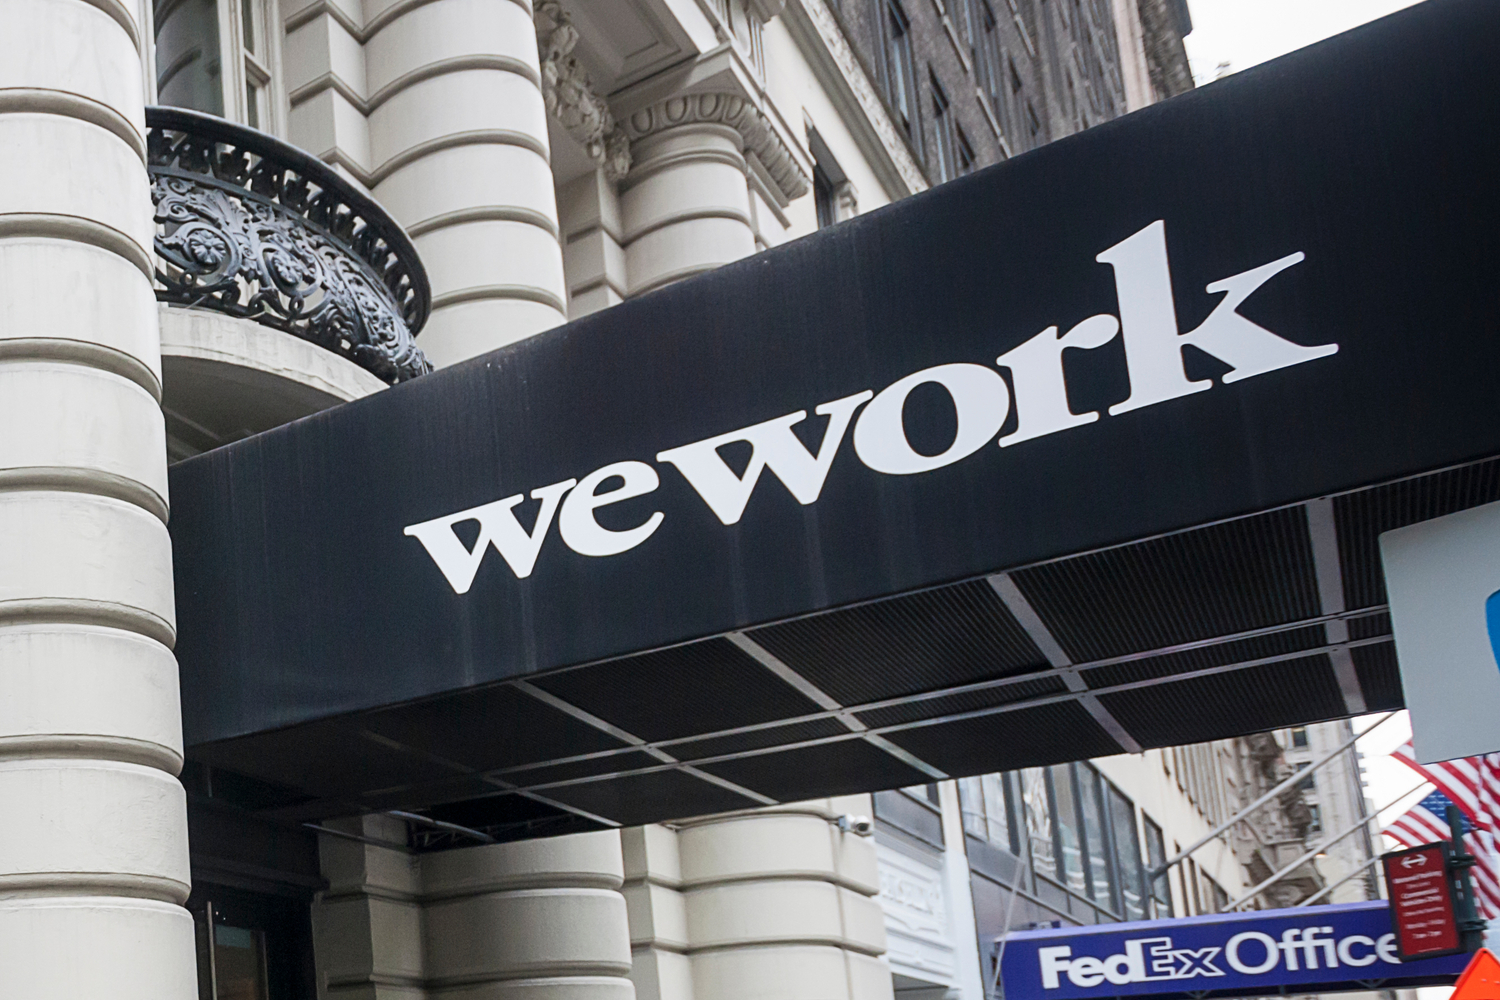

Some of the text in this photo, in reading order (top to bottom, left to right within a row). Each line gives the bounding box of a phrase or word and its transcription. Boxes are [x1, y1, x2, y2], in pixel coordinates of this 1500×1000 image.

[403, 218, 1339, 596] wework
[1038, 926, 1403, 990] FedEx Office
